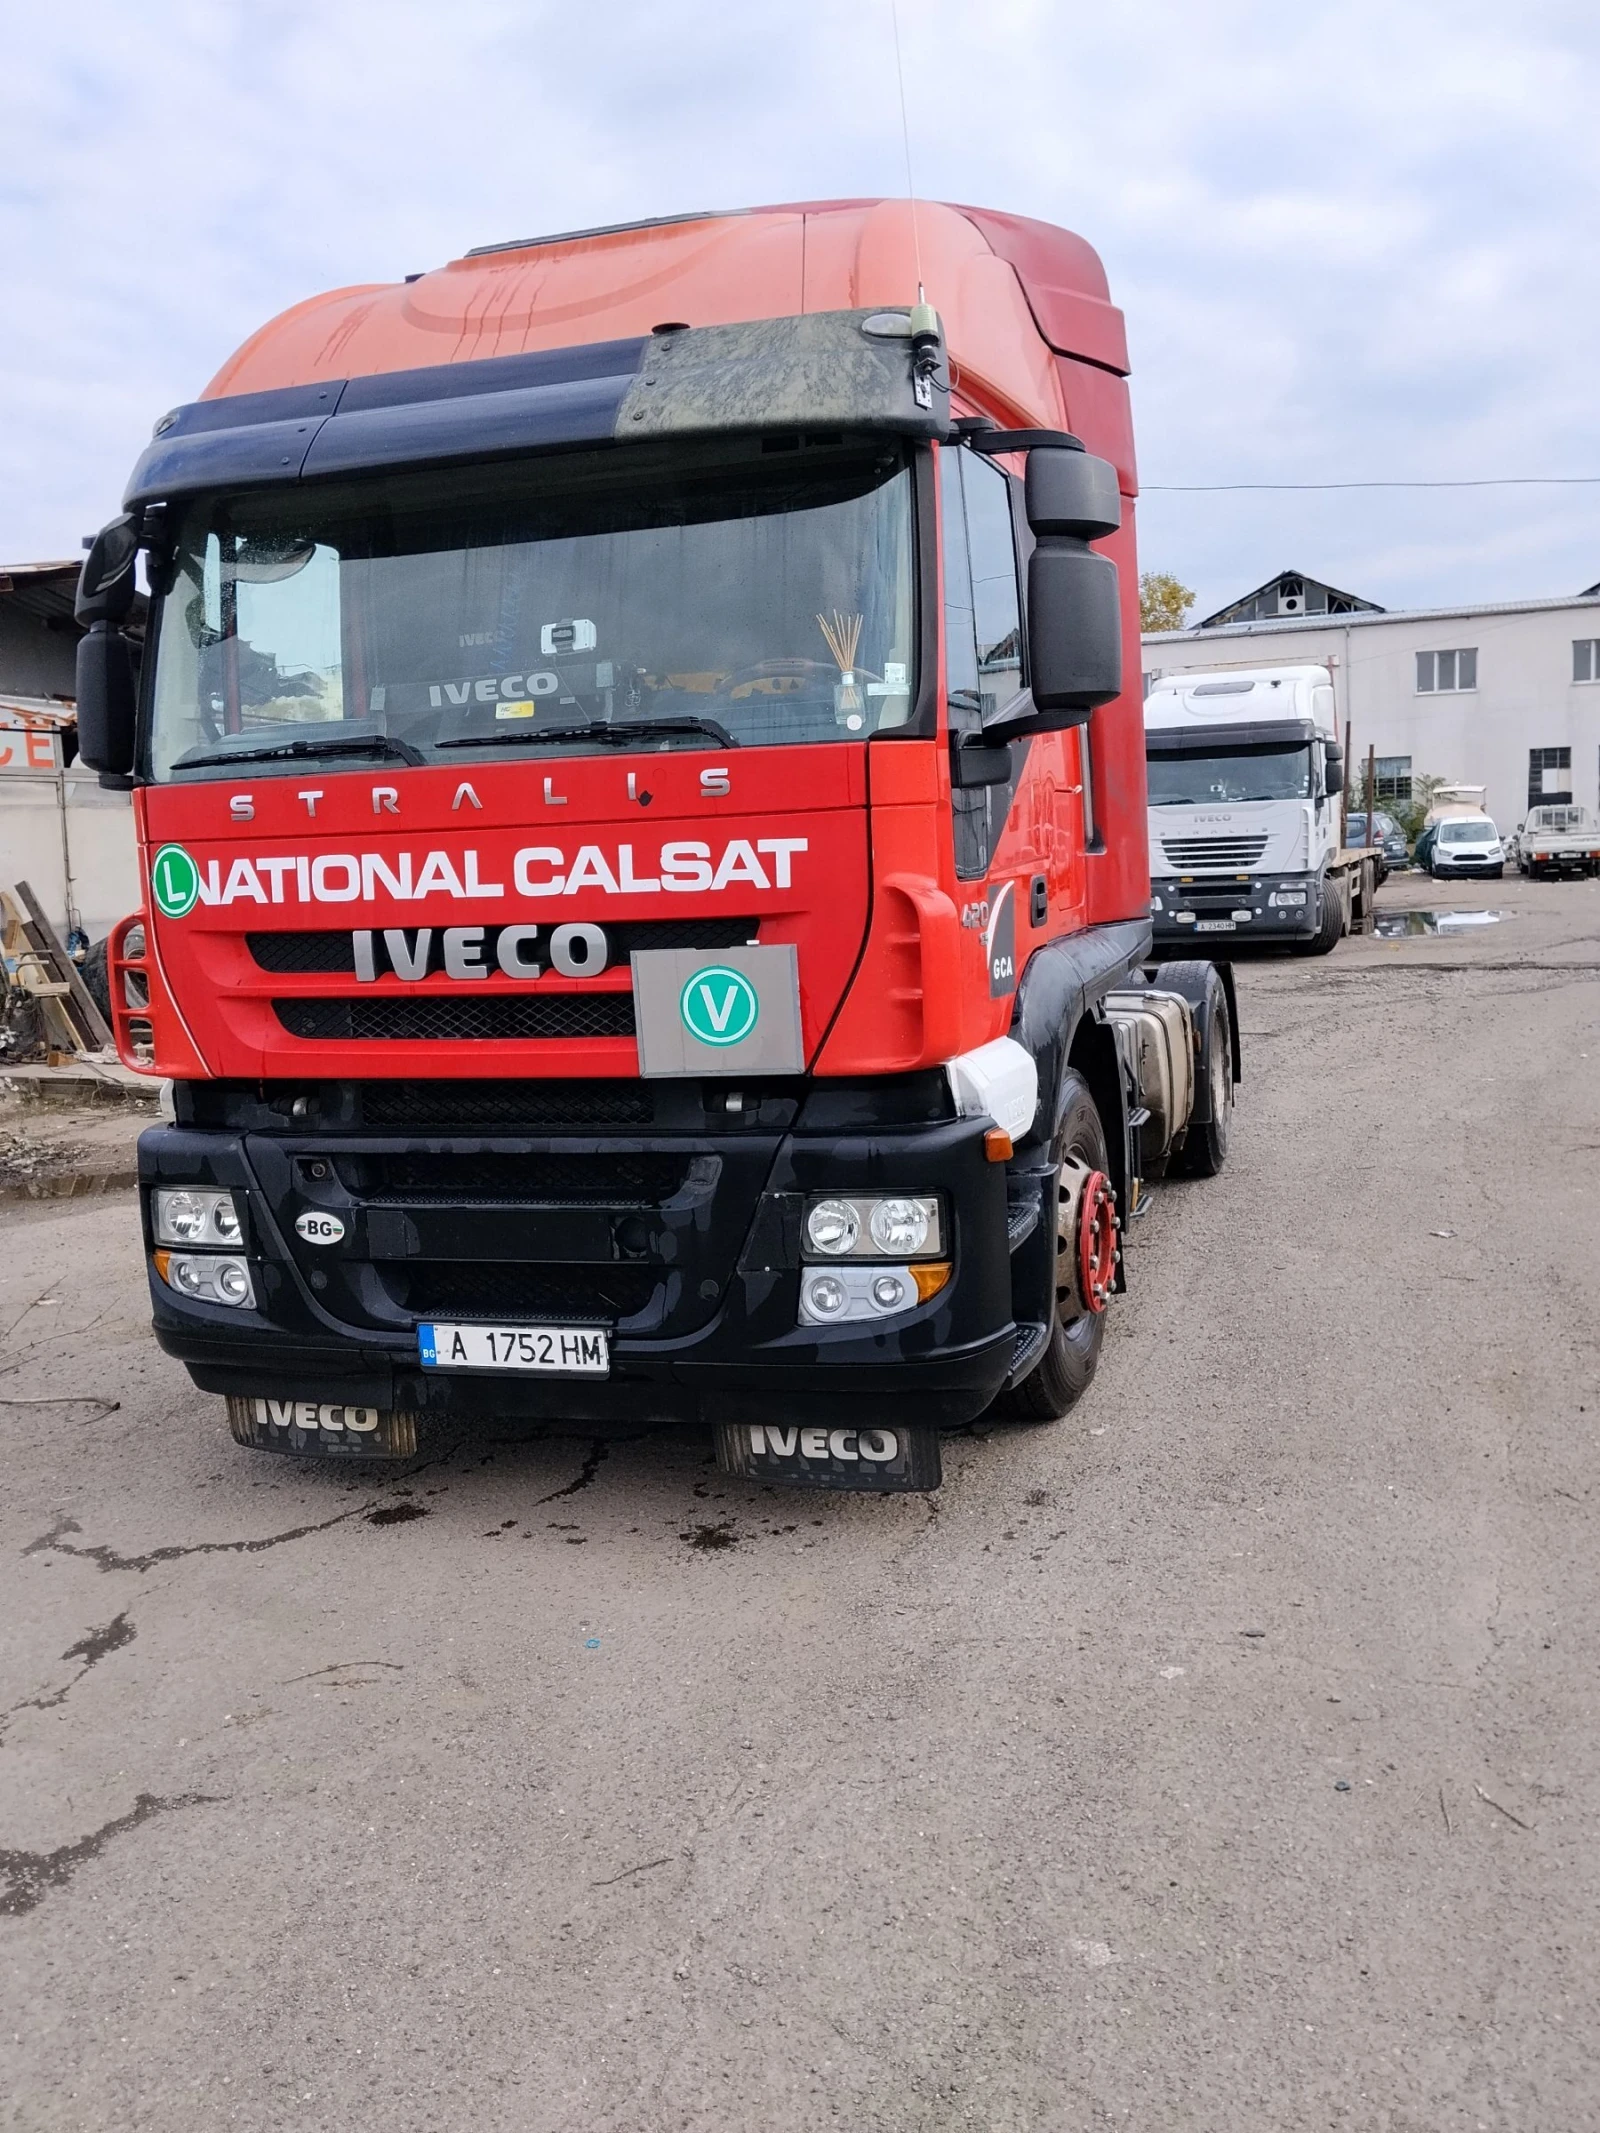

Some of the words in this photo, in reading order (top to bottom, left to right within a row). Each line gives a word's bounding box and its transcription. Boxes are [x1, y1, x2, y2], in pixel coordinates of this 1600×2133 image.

[428, 672, 559, 707] IVECO
[230, 768, 732, 822] STRALIS
[1193, 814, 1232, 823] IVECO
[162, 860, 187, 903] L
[198, 849, 505, 906] NATIONAL
[513, 837, 809, 897] CALSAT
[962, 901, 989, 929] 420
[352, 922, 608, 982] IVECO
[993, 956, 1013, 980] GCA
[699, 984, 739, 1032] V
[307, 1219, 332, 1237] BG
[423, 1349, 436, 1359] BG
[451, 1331, 468, 1361] A
[486, 1332, 555, 1365] 1752
[560, 1335, 602, 1366] HM
[255, 1398, 379, 1432] IVECO
[750, 1424, 898, 1462] IVECO
